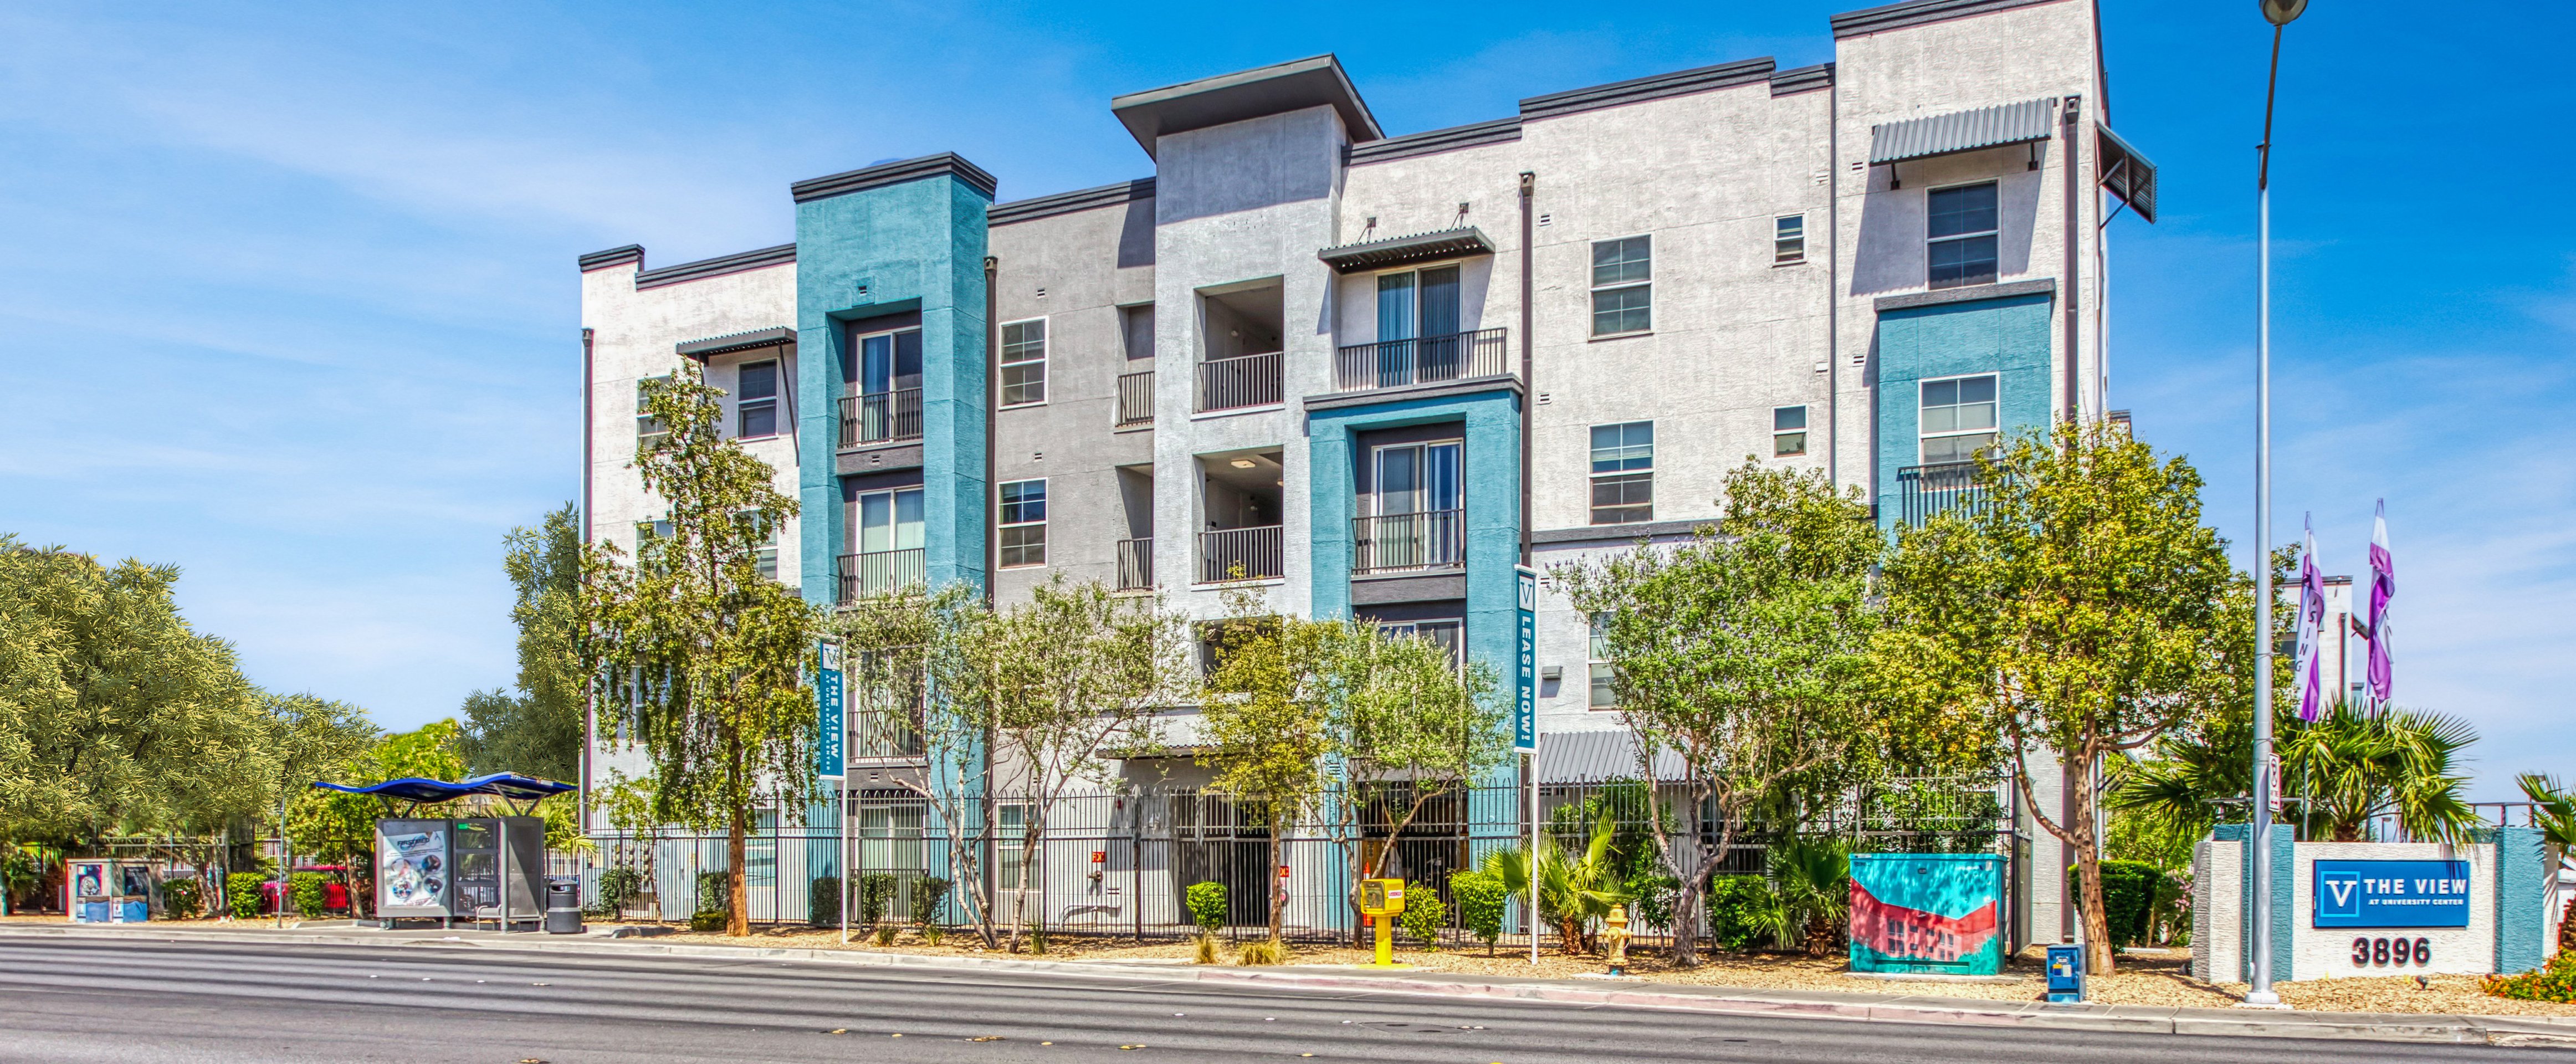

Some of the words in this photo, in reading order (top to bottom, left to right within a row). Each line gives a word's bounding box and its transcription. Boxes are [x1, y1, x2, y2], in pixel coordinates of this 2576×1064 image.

[1520, 582, 1532, 604] V
[824, 648, 837, 665] V
[1522, 616, 1531, 678] LEASE
[826, 674, 829, 684] AT
[1522, 686, 1530, 741] NOW!
[2325, 880, 2357, 907] V
[2363, 878, 2405, 894] THE
[2415, 878, 2467, 895] VIEW
[2352, 937, 2430, 965] 3896
